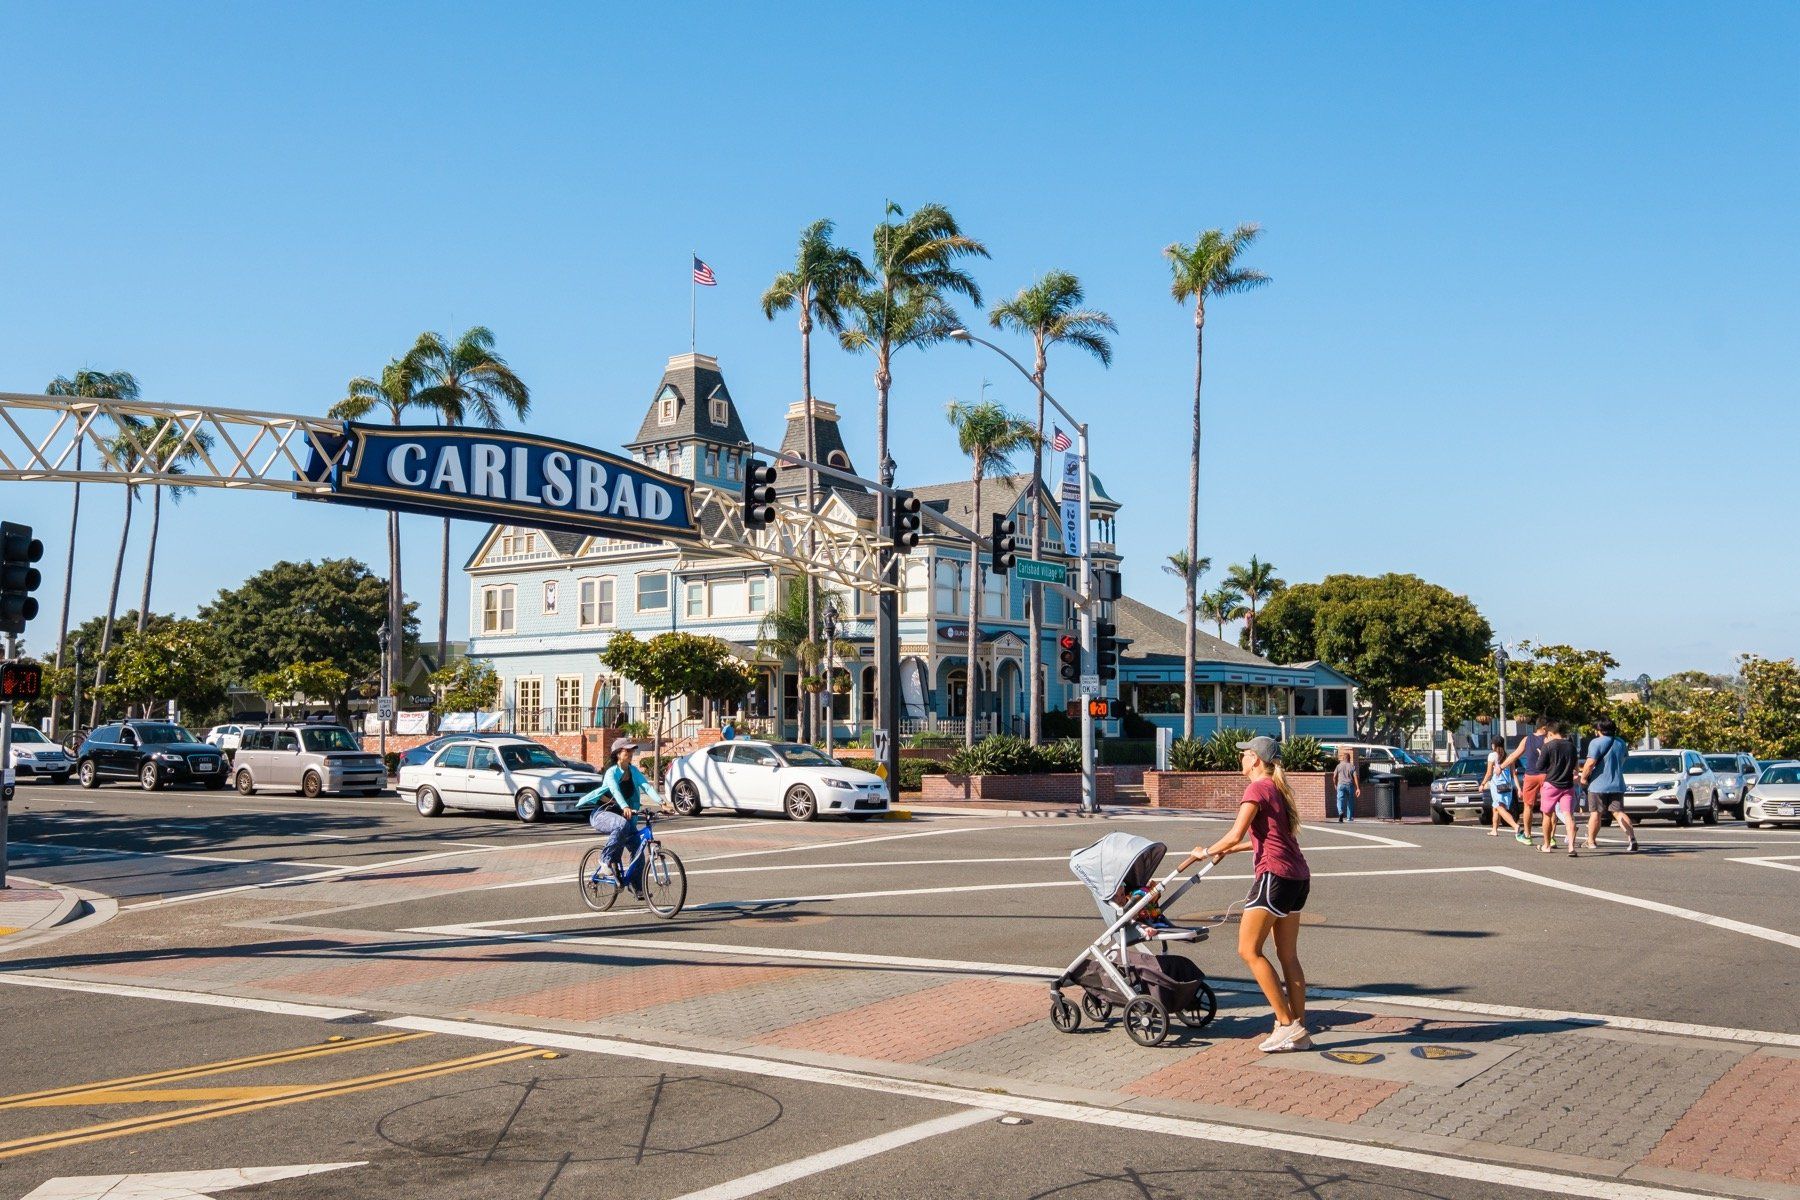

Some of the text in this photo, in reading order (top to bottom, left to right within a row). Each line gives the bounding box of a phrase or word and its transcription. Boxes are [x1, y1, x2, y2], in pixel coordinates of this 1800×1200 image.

[387, 443, 673, 521] CARLSBAD
[1067, 508, 1077, 554] 2020
[1018, 562, 1040, 576] Carlsbad
[1041, 566, 1057, 580] Village
[1082, 685, 1091, 693] OK
[379, 709, 392, 718] 30
[1097, 702, 1107, 715] 20
